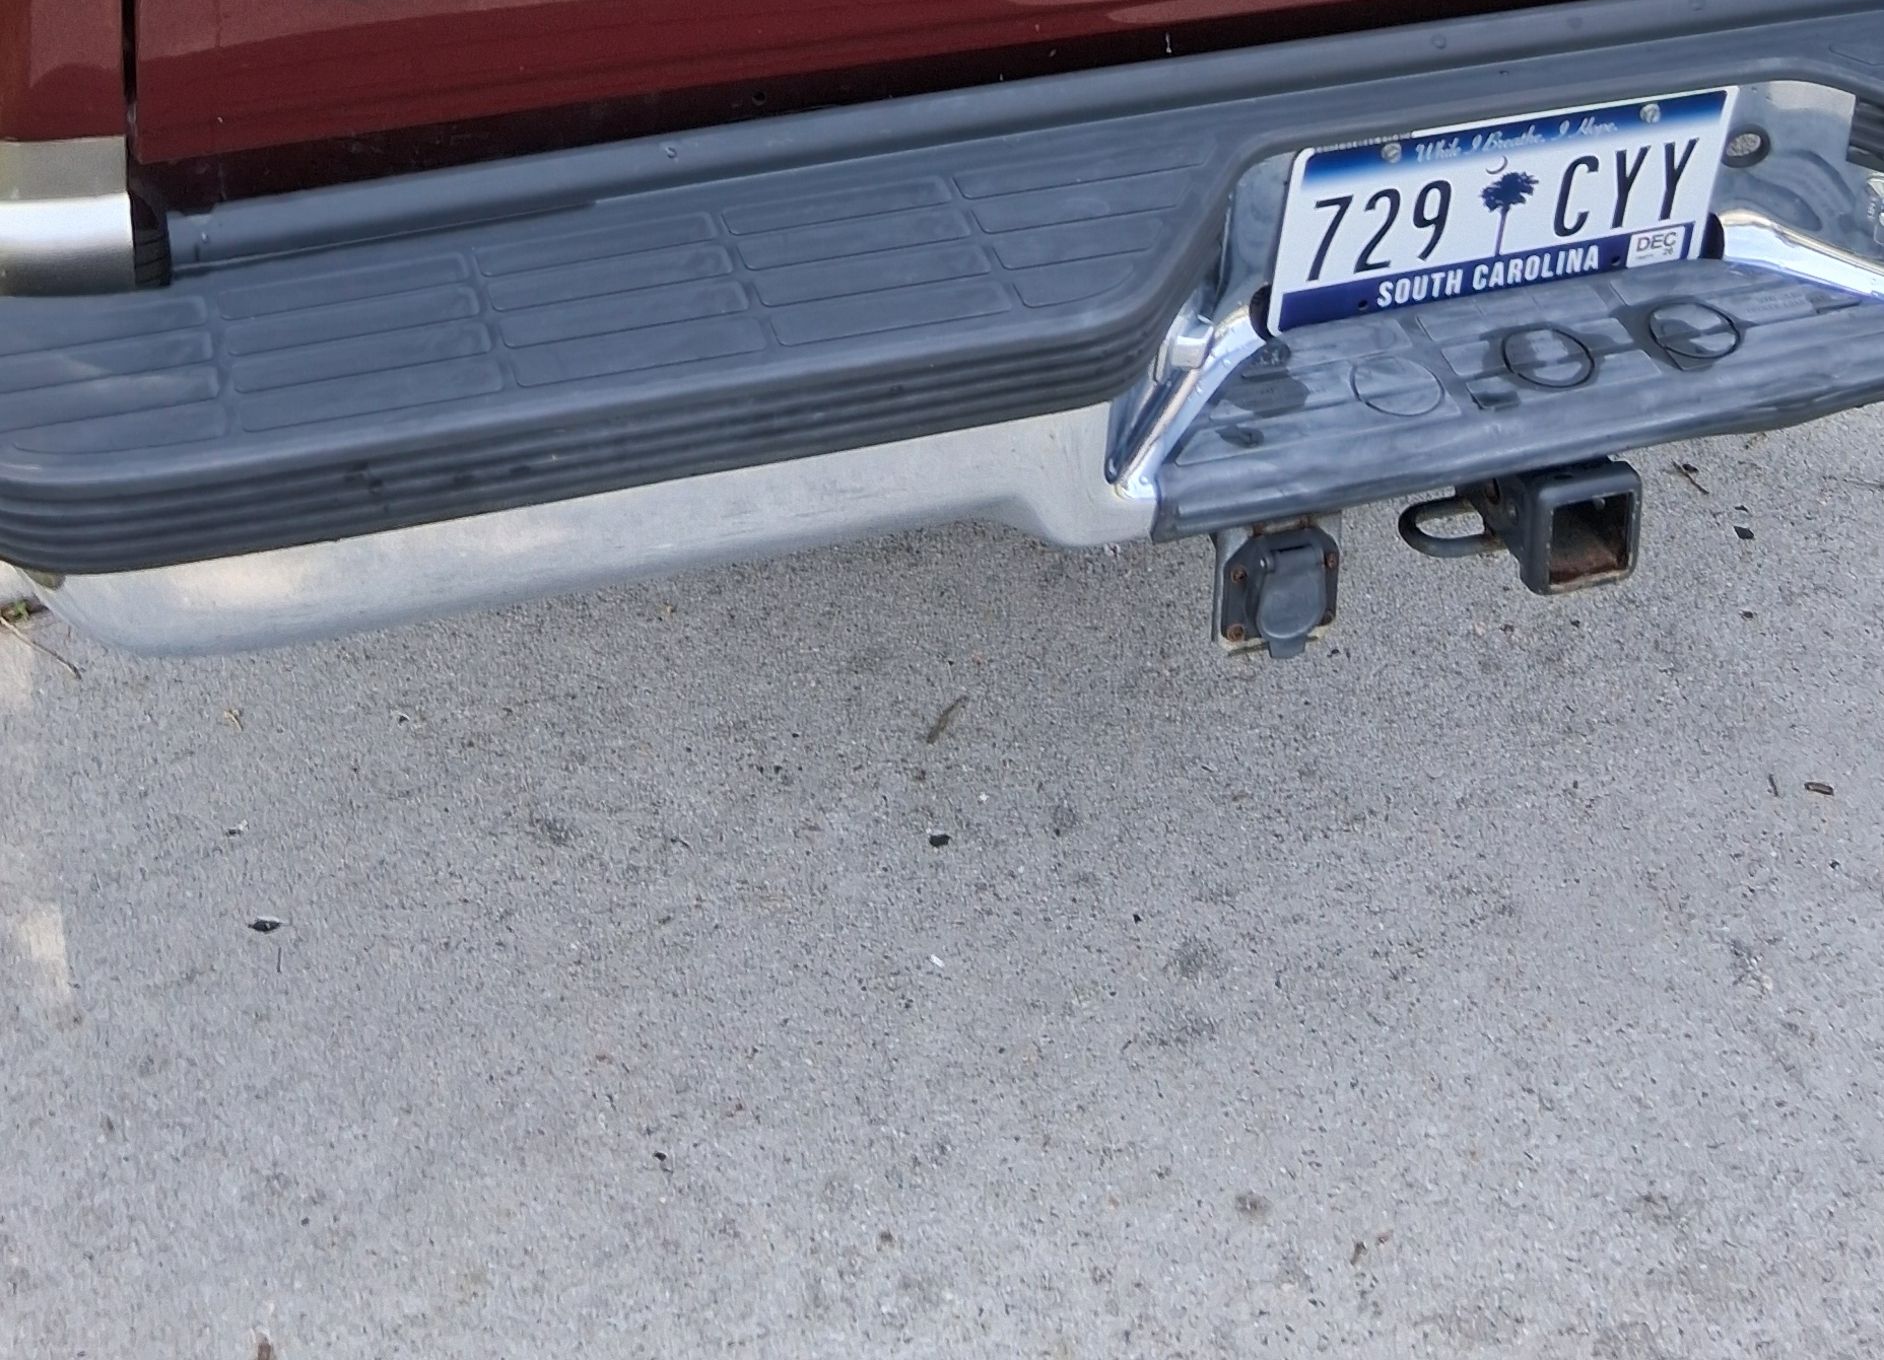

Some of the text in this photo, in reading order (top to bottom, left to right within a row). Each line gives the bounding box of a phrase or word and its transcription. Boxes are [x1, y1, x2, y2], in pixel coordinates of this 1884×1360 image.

[1306, 137, 1700, 282] 729 CYY
[1636, 231, 1677, 252] DEC
[1377, 245, 1600, 308] SOUTH CAROLINA
